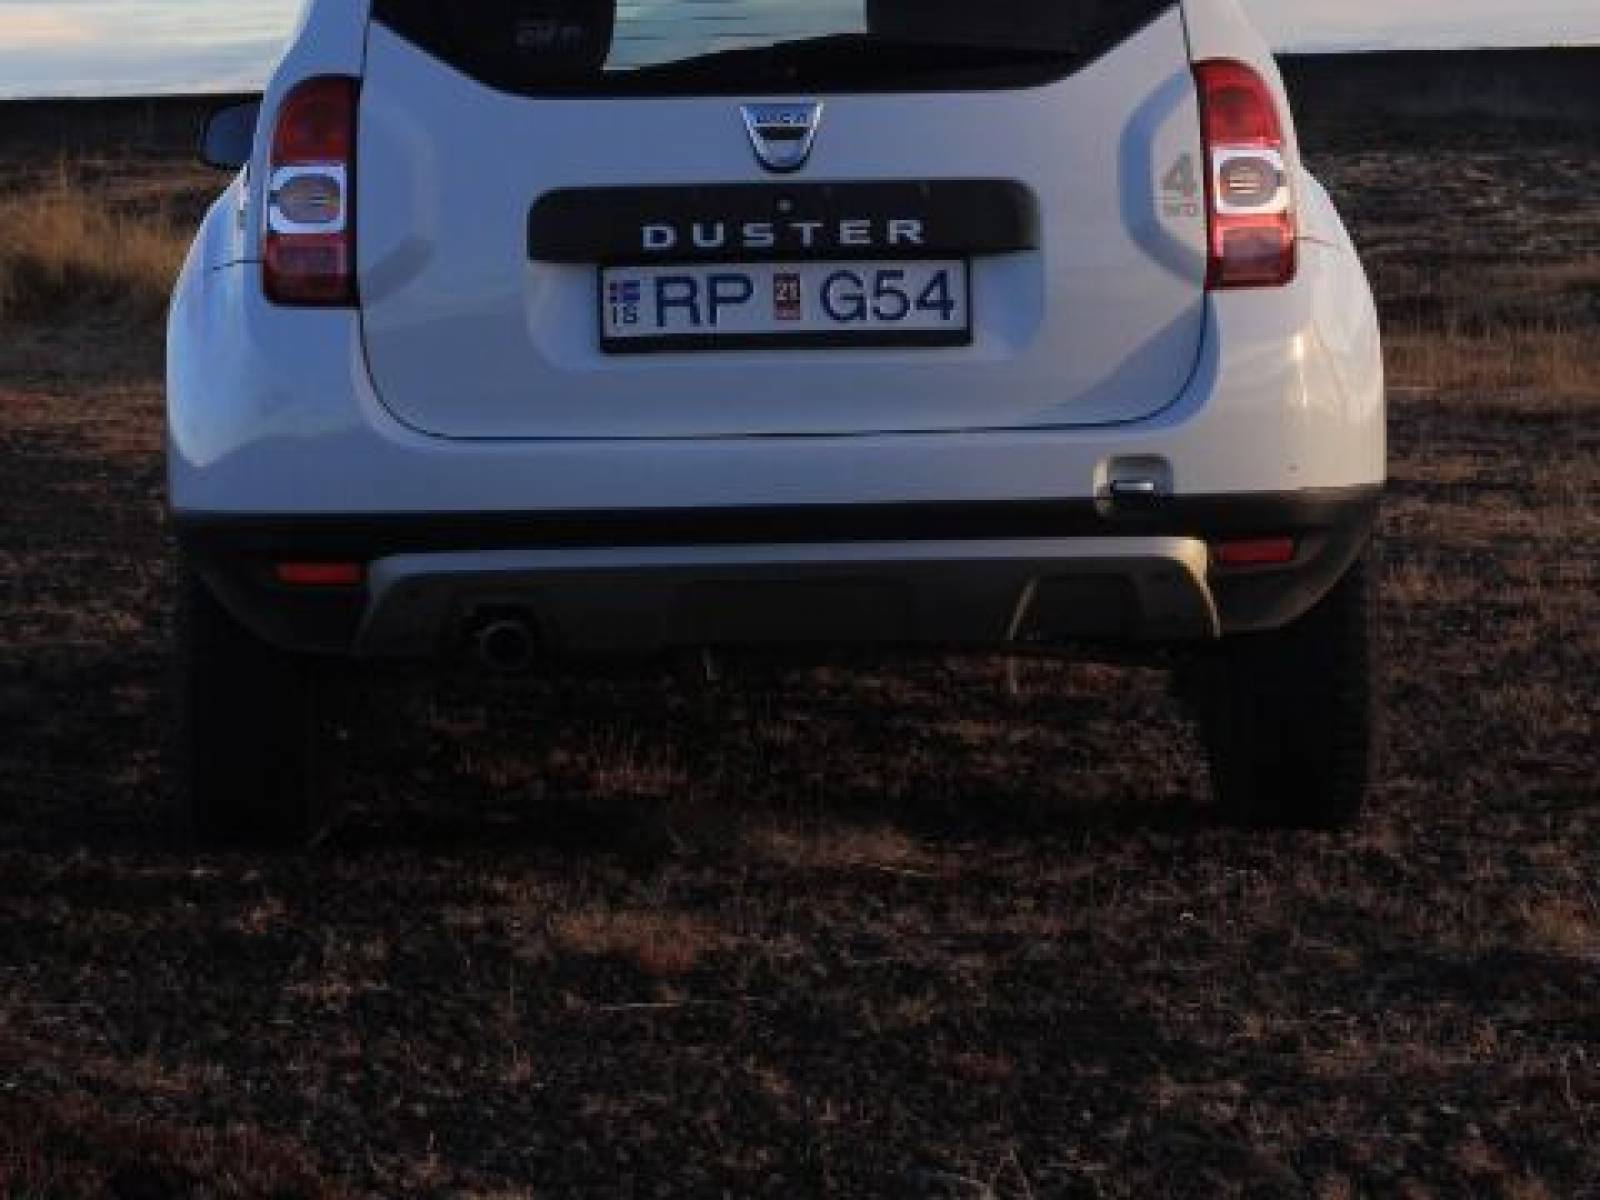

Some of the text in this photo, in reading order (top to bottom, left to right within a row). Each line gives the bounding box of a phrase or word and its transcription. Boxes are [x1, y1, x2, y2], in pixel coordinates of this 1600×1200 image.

[640, 218, 925, 249] DUSTER
[655, 272, 755, 328] RP
[819, 268, 956, 323] G54
